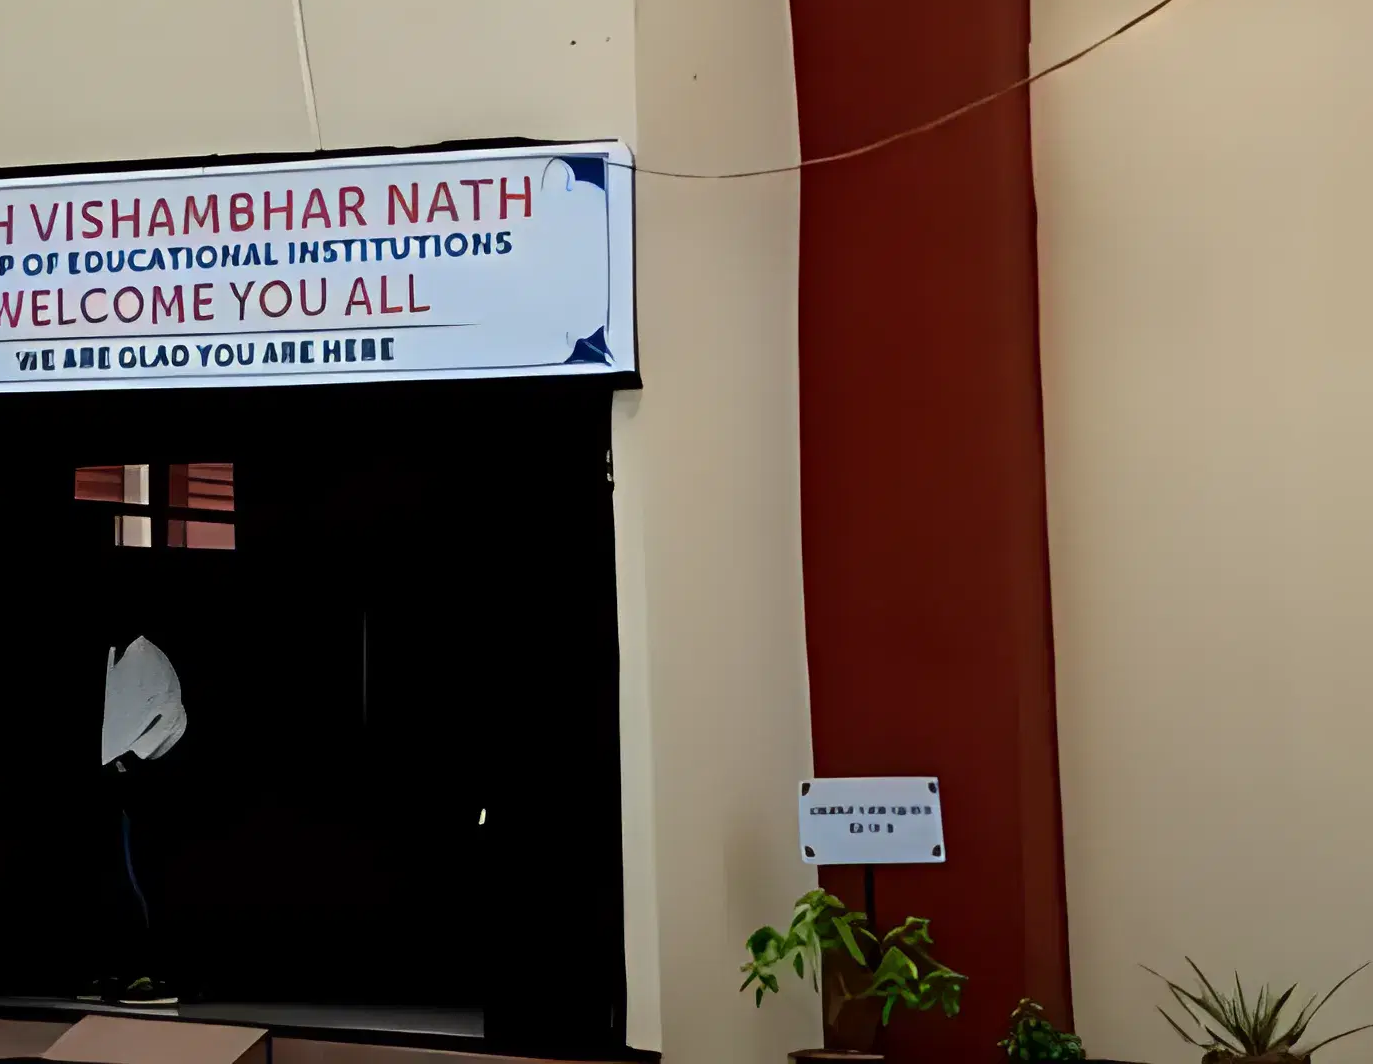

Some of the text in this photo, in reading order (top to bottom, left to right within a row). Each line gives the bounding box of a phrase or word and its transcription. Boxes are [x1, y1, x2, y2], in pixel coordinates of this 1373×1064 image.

[29, 185, 368, 243] VISHAMBHAR
[387, 175, 532, 226] NATH
[67, 241, 279, 276] EDUCATIONAL
[287, 230, 513, 266] INSTITUTIONS
[228, 276, 327, 322] YOU
[343, 273, 431, 317] ALL
[195, 342, 255, 368] YOU
